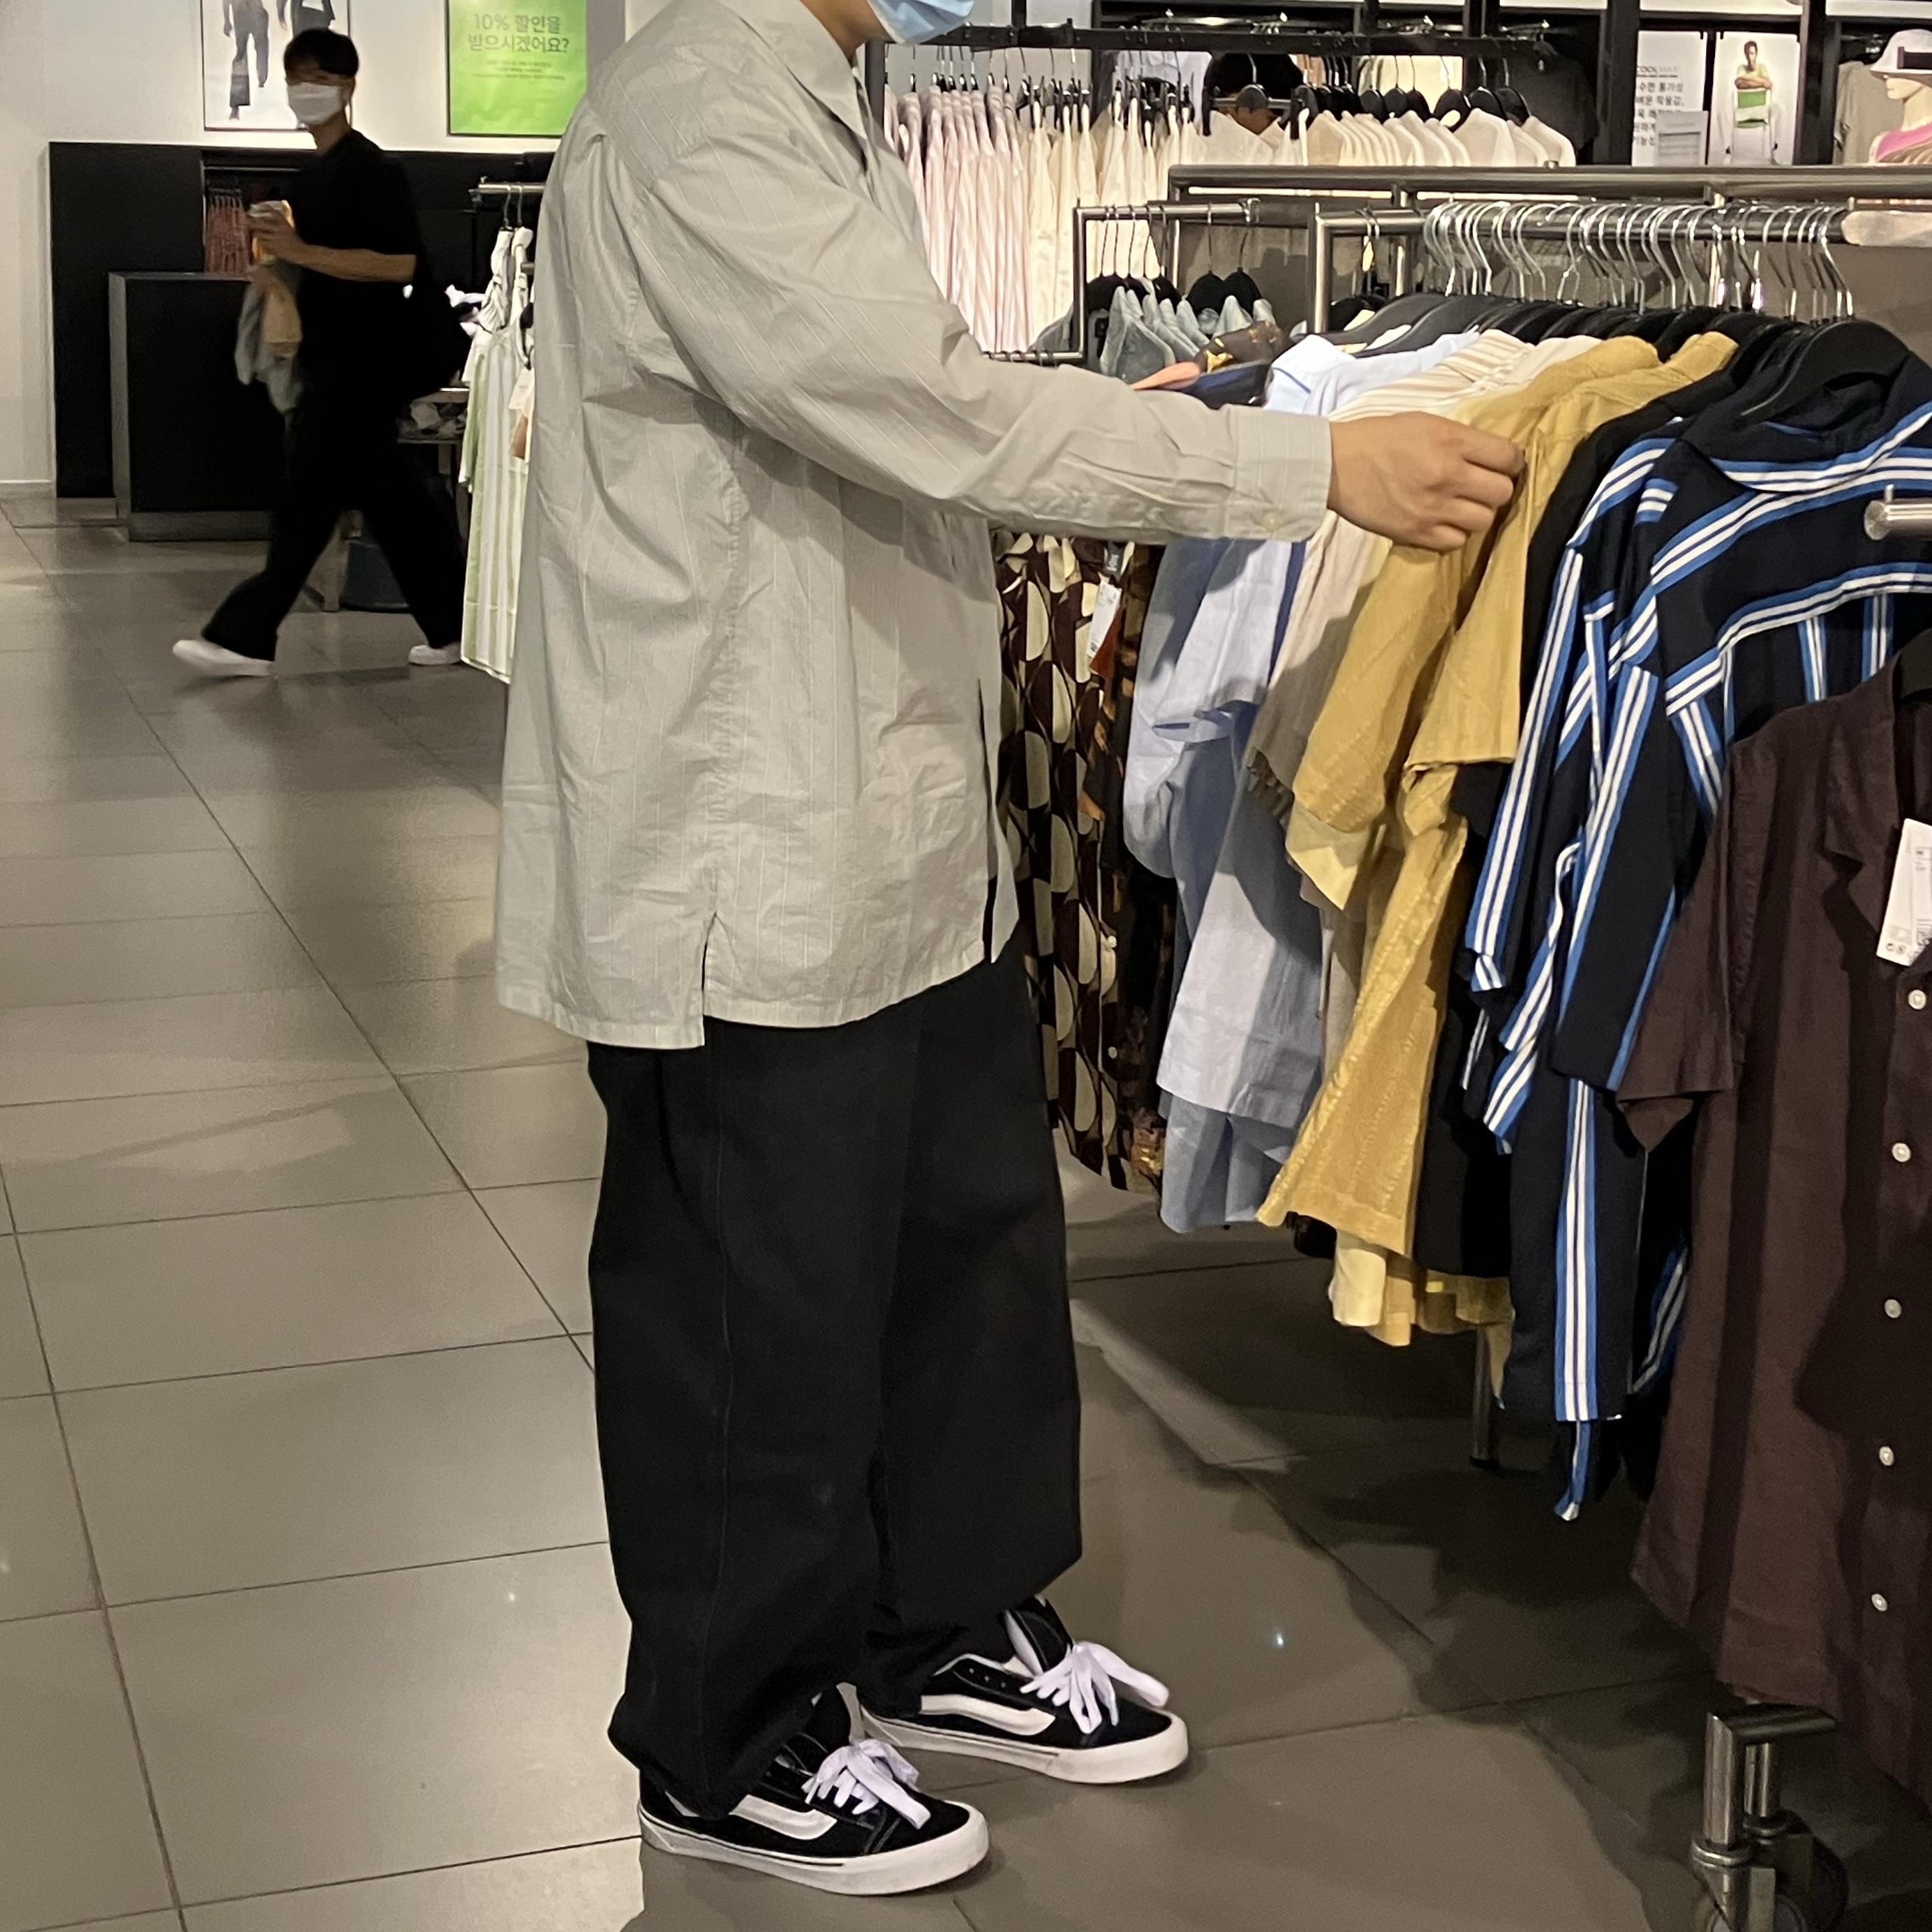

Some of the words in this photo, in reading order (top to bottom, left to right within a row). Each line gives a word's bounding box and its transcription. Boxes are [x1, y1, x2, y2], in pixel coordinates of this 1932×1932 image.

[474, 13, 510, 31] 10%
[515, 15, 561, 34] 할인을
[468, 34, 570, 53] 받으시겠어요?
